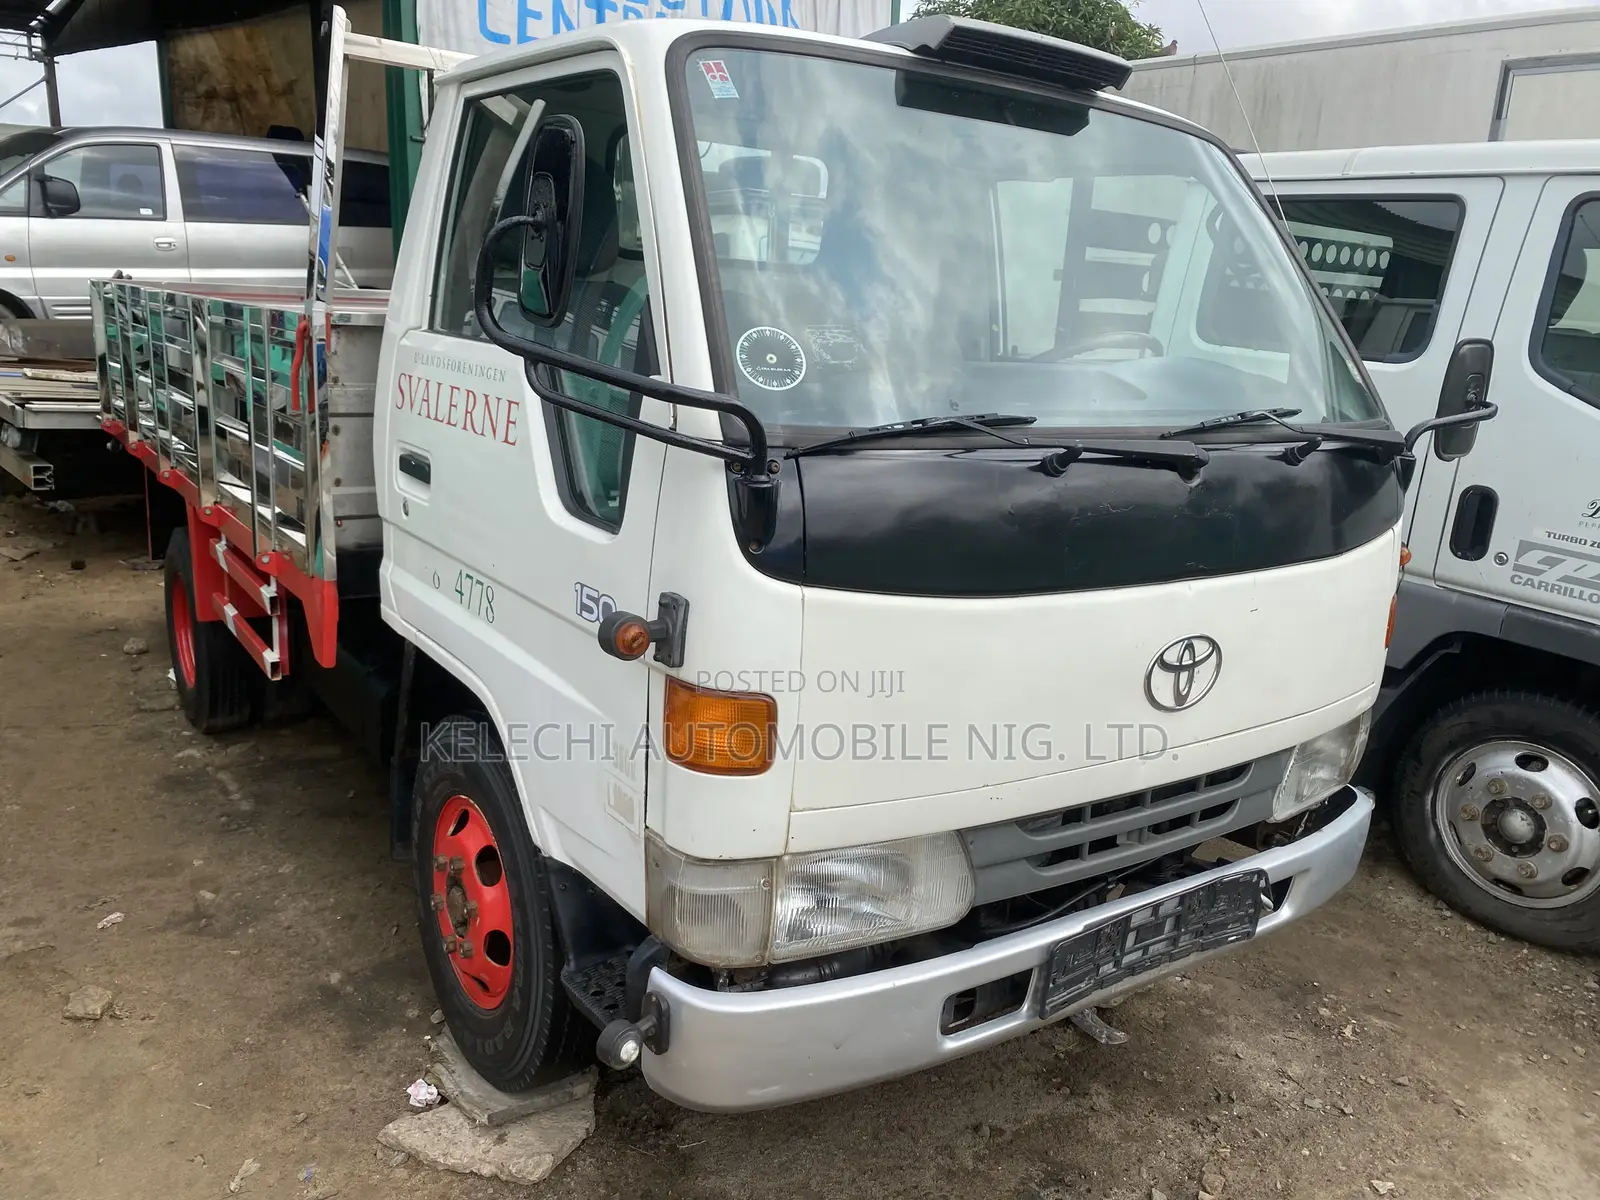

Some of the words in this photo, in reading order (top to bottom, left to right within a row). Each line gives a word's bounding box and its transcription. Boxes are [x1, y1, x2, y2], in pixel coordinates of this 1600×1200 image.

[395, 372, 521, 446] SVALERNE
[1545, 530, 1588, 546] TURBO
[454, 569, 495, 624] 4778
